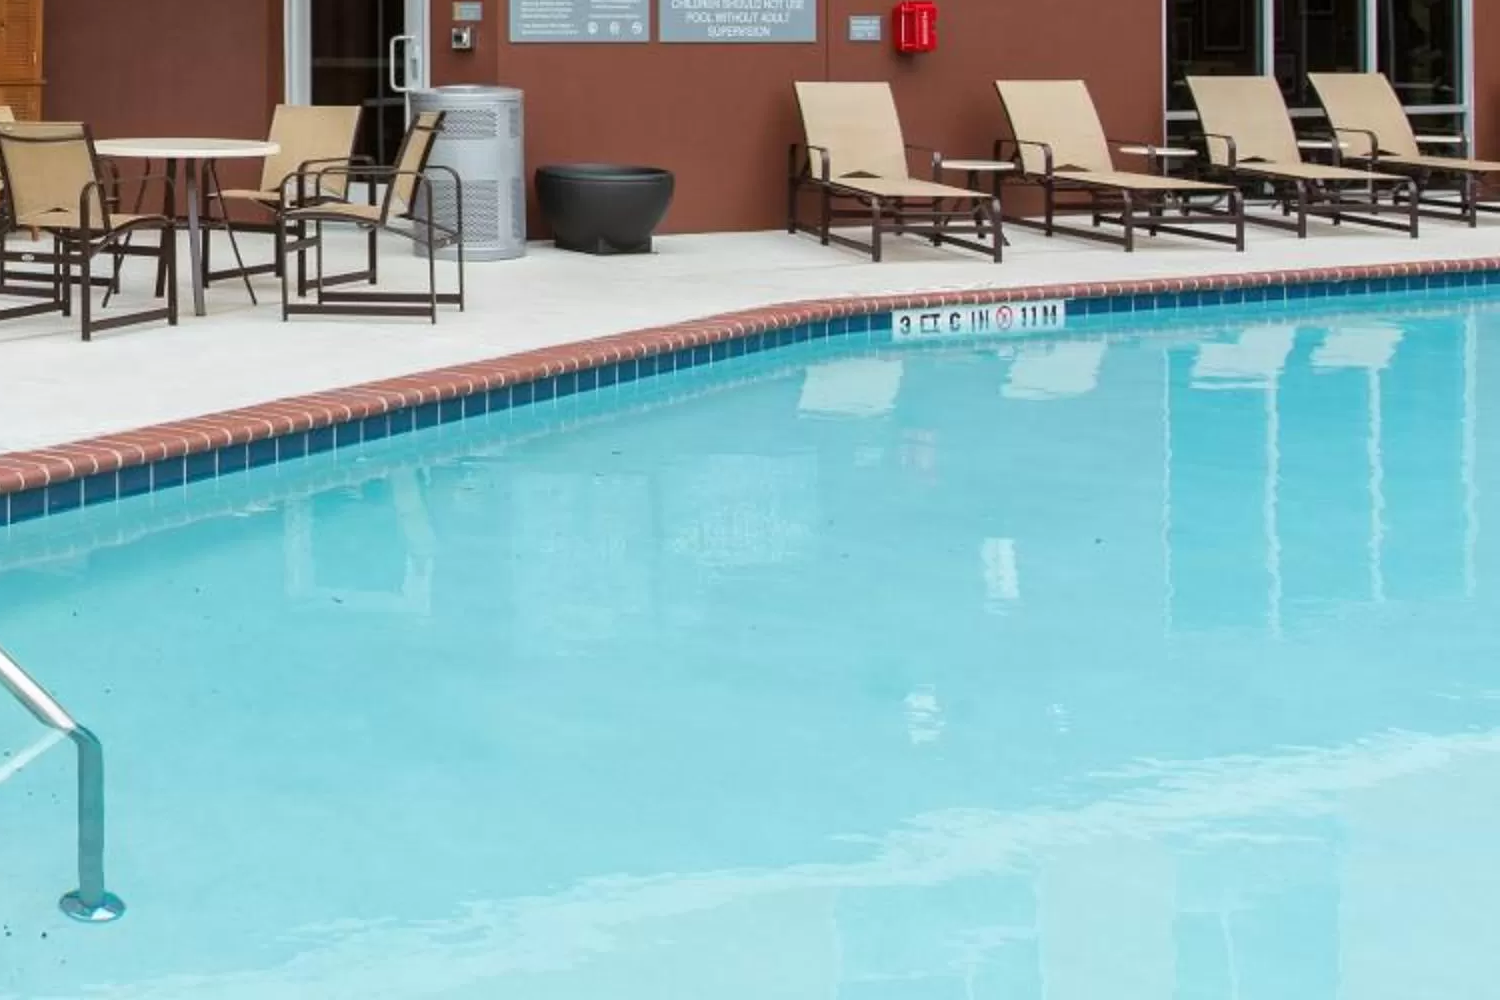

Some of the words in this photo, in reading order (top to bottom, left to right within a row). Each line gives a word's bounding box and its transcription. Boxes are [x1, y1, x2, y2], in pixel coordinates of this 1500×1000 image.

[763, 0, 783, 9] NOT
[785, 0, 805, 10] USE
[685, 11, 710, 23] POOL
[715, 11, 759, 23] WITHOUT
[761, 11, 791, 24] ADULT
[707, 25, 772, 37] SUPERVISION
